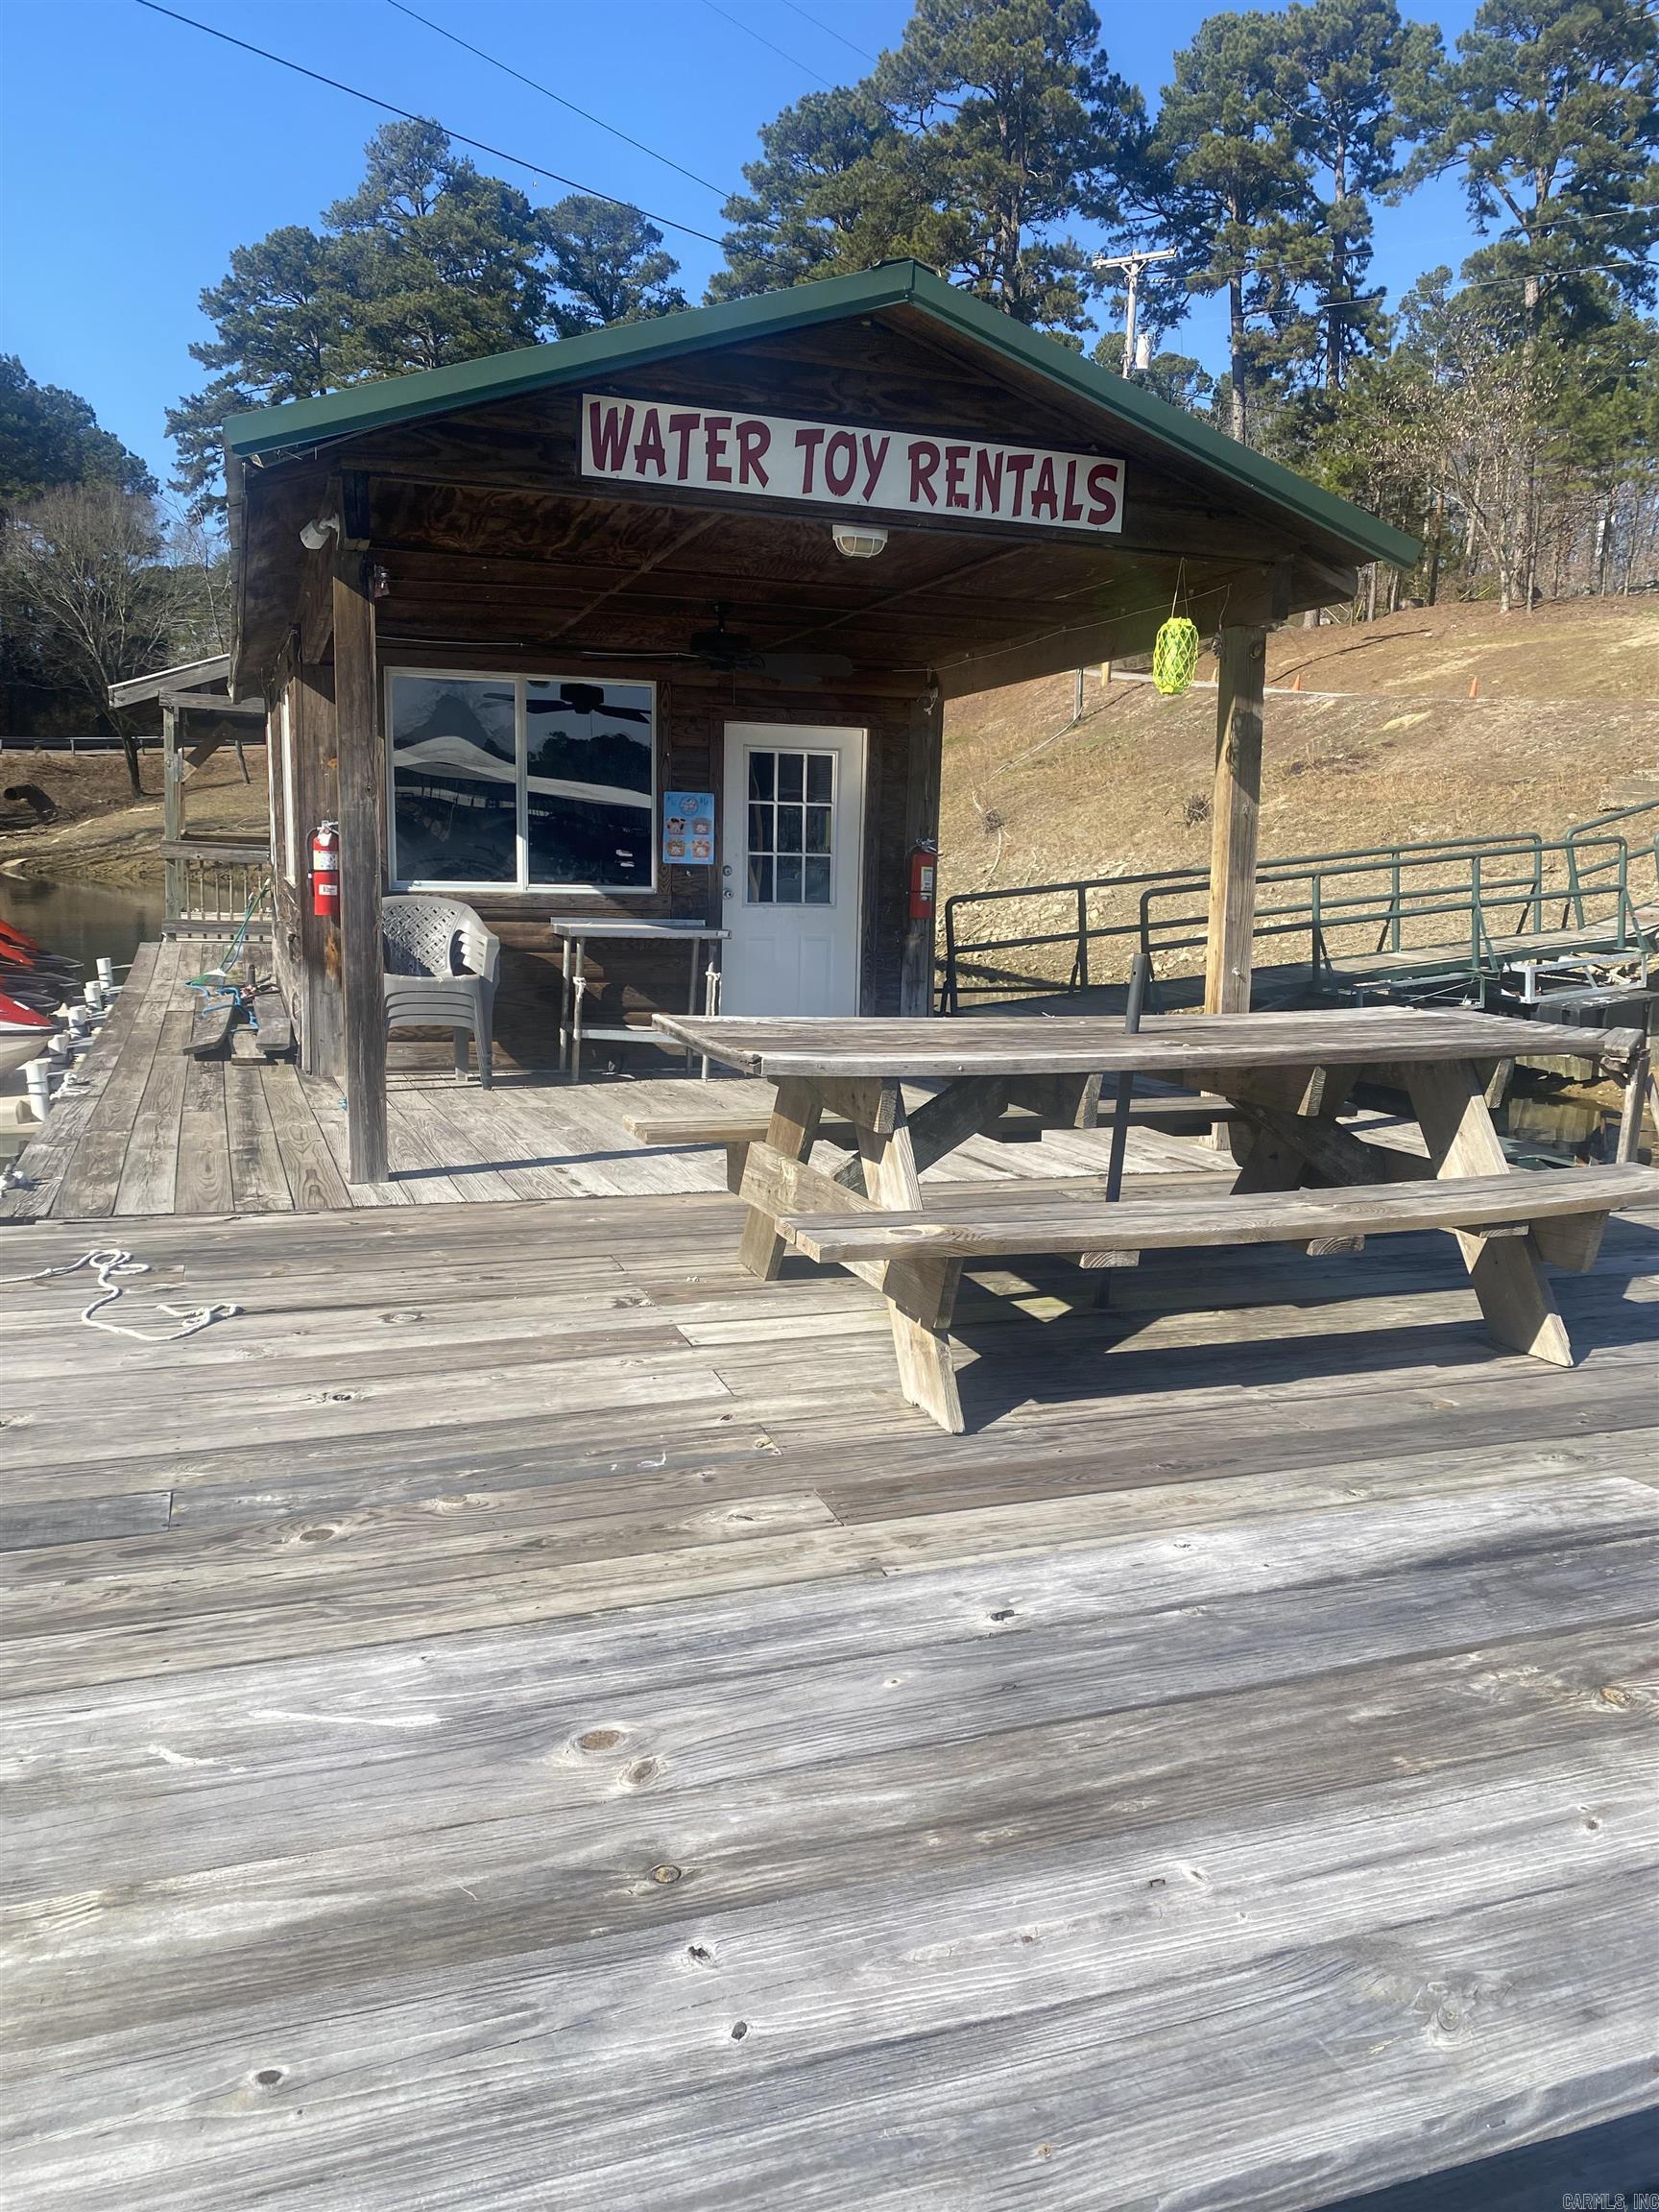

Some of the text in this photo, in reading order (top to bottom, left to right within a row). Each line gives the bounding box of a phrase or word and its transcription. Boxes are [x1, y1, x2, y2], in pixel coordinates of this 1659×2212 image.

[589, 400, 1118, 526] WATER TOY RENTALS
